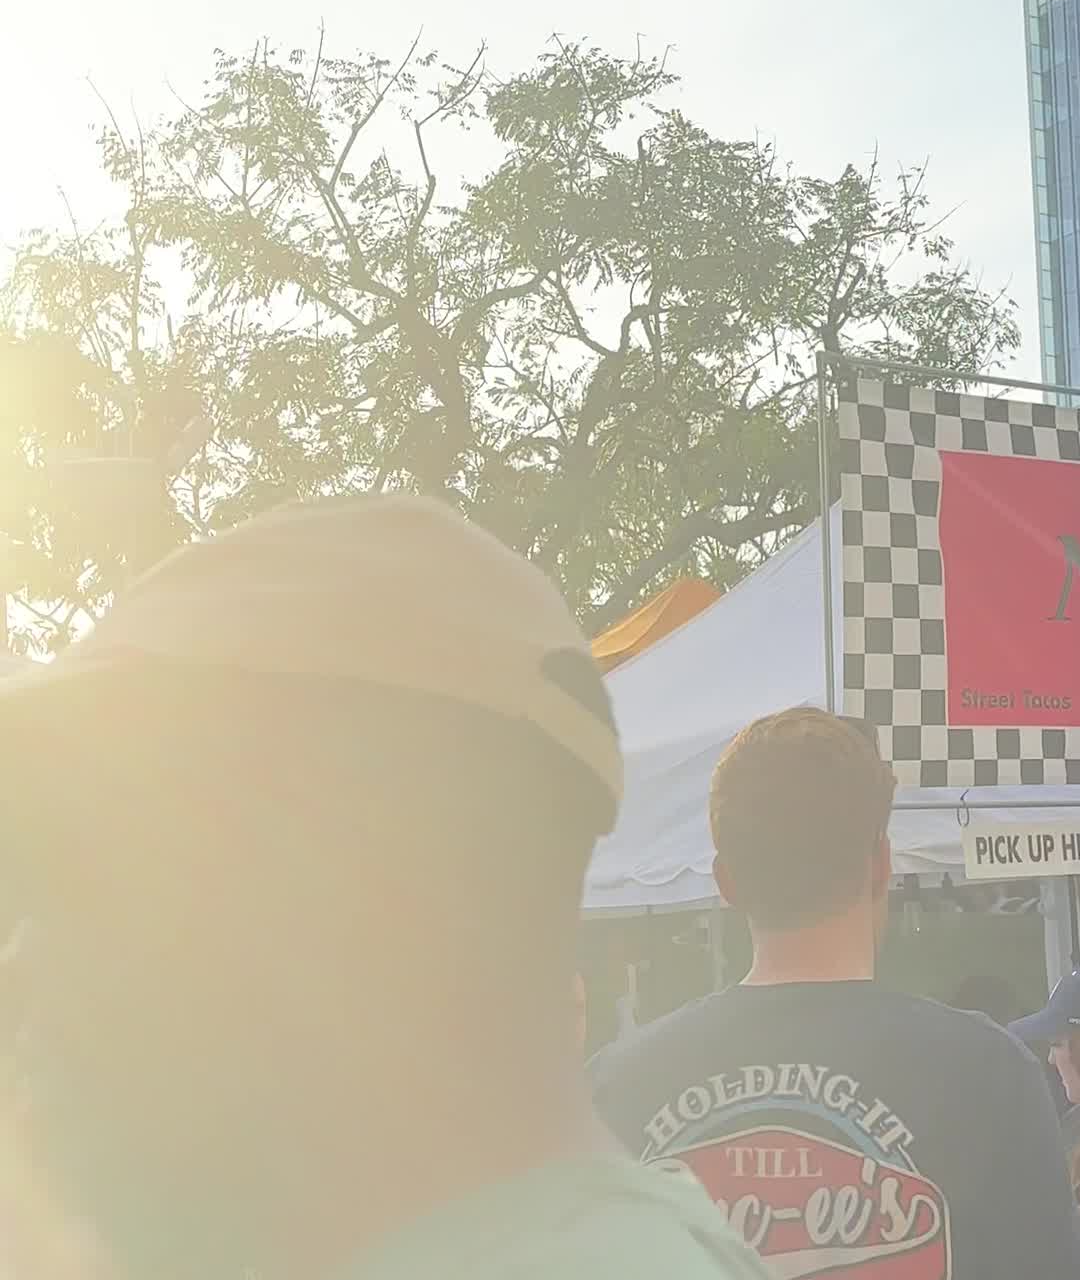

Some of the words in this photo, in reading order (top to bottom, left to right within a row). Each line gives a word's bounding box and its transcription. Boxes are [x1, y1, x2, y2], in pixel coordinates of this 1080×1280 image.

[961, 687, 1015, 710] Street
[1021, 689, 1072, 710] Tacos
[975, 835, 1023, 864] PICK
[1028, 834, 1054, 862] UP
[725, 1146, 824, 1178] TILL
